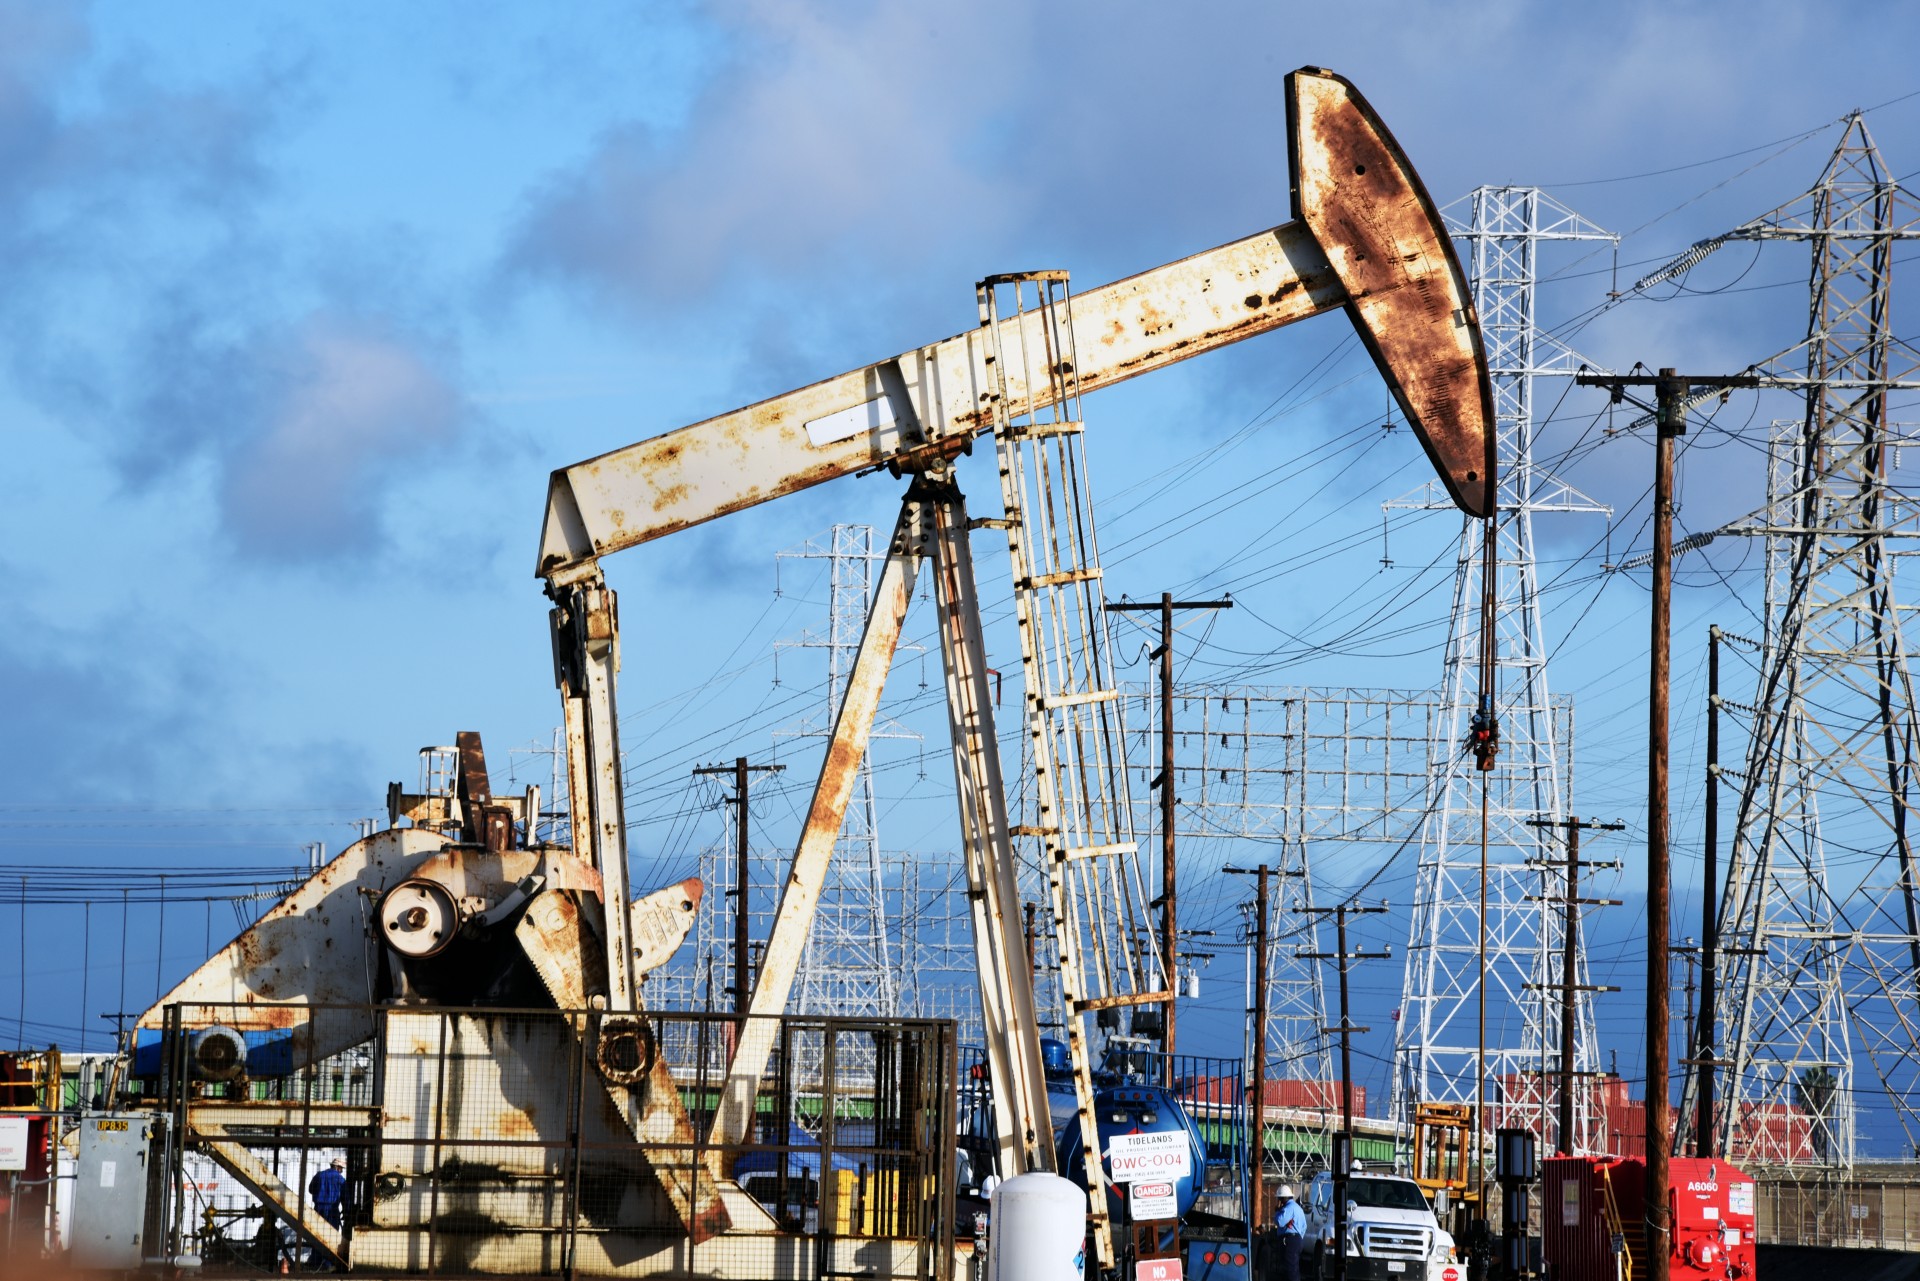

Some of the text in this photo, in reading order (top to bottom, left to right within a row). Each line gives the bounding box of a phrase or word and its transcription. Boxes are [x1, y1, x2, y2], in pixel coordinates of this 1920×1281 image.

[97, 1121, 128, 1131] UP835
[1127, 1135, 1173, 1146] TIDELANDS
[1136, 1185, 1170, 1196] DANGER
[1687, 1182, 1718, 1192] A6060
[1152, 1265, 1167, 1279] NO
